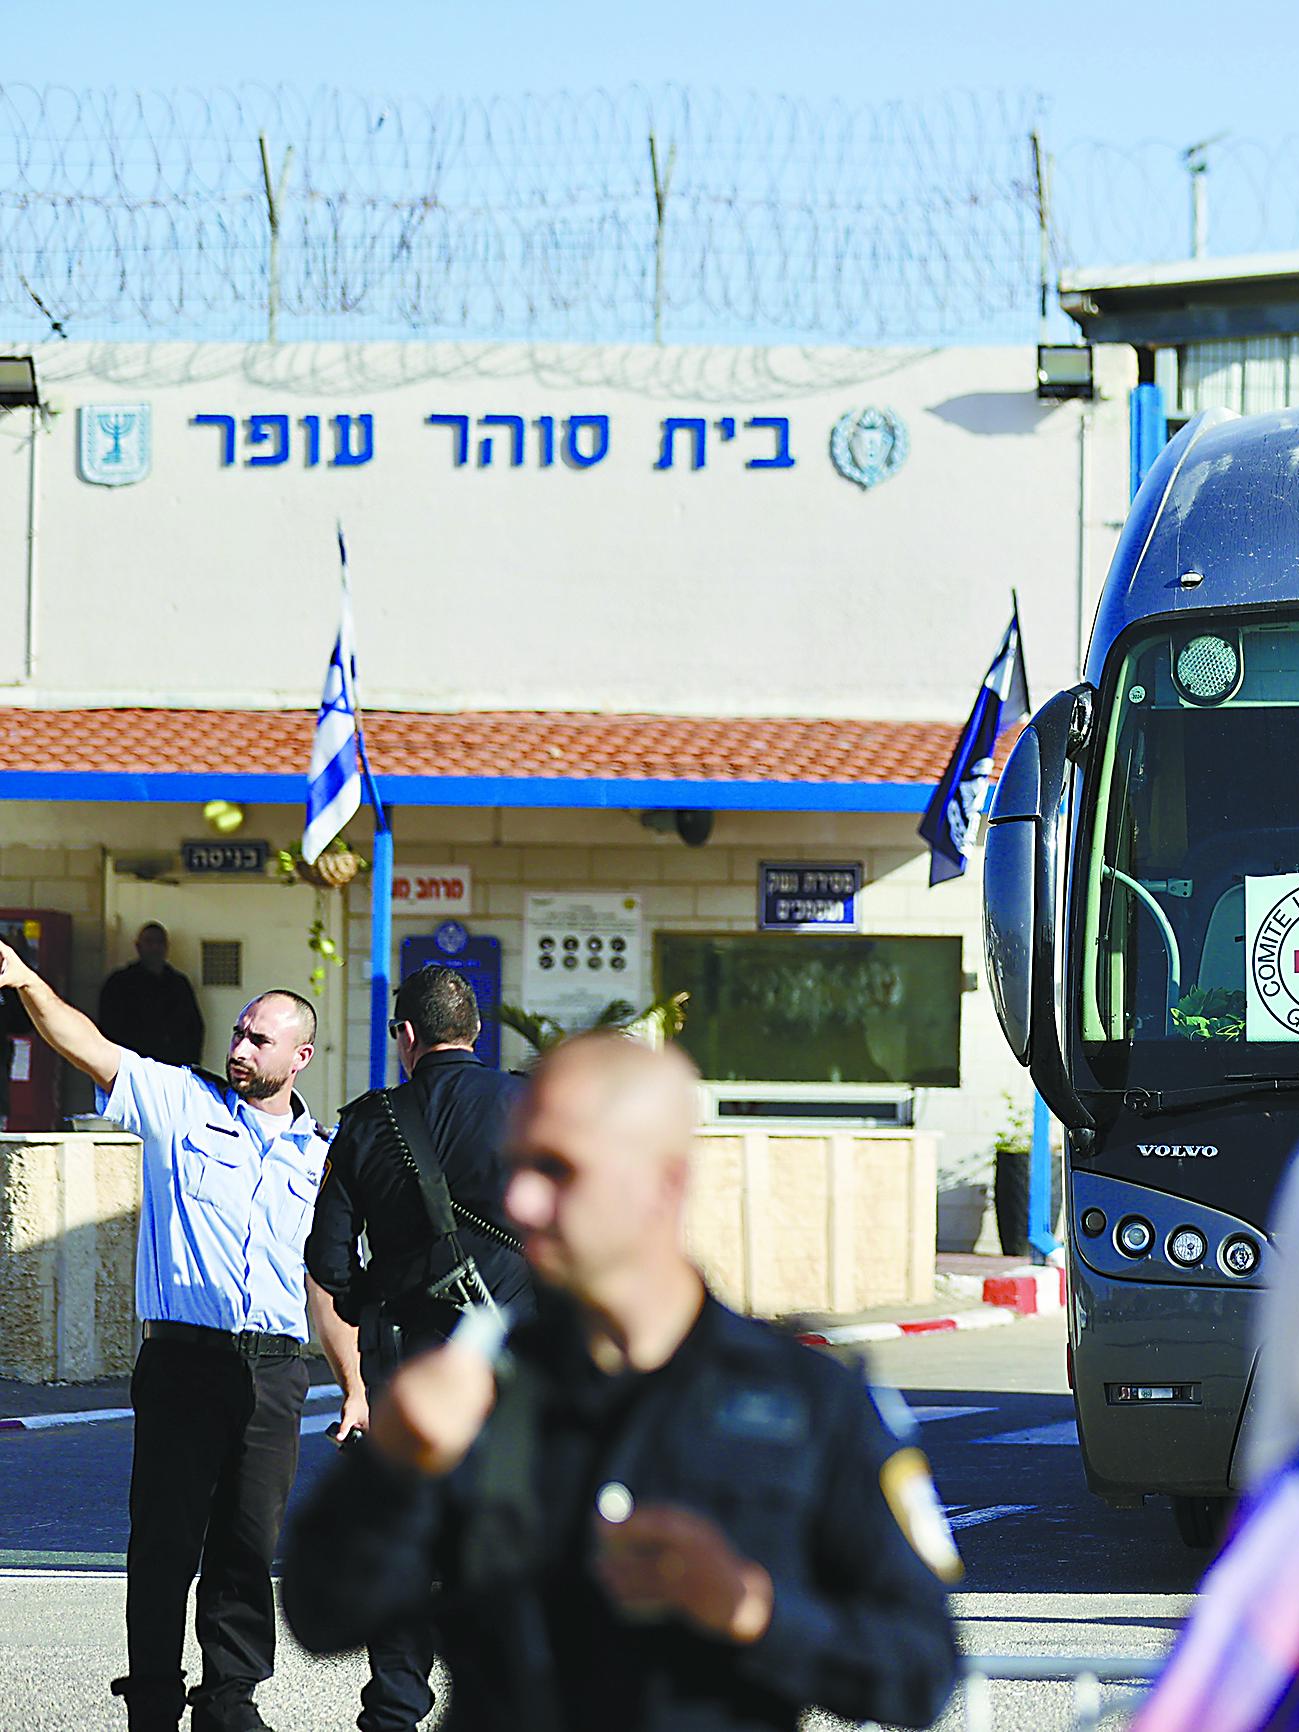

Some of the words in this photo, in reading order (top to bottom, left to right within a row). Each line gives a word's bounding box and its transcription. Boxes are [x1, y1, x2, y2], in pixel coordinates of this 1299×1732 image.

[194, 413, 375, 467] עופר
[429, 413, 610, 468] סוהר
[657, 417, 796, 469] בית
[191, 847, 258, 868] כניסה
[416, 876, 464, 900] מרחב
[1257, 908, 1292, 998] COMITE
[1136, 1144, 1219, 1157] VOLVO
